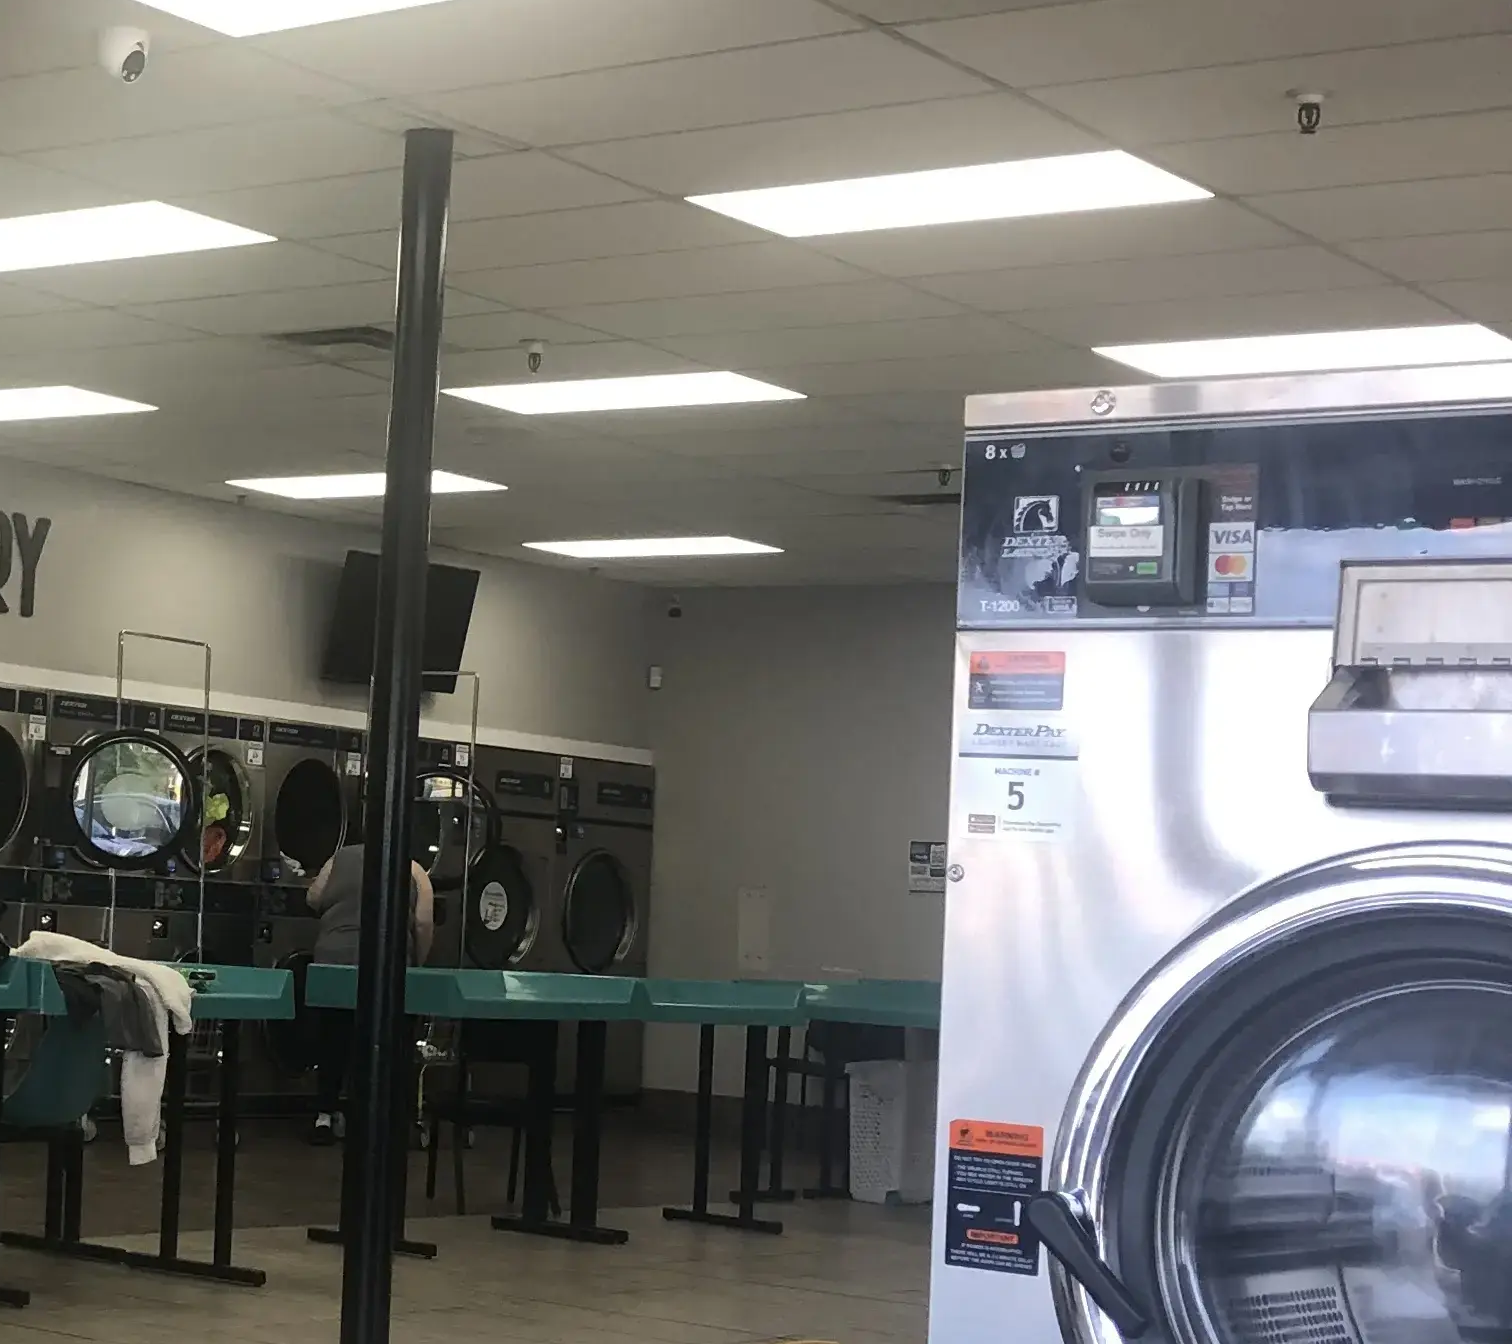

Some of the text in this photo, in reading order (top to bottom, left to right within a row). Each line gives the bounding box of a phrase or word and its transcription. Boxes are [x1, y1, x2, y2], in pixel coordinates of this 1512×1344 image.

[985, 444, 996, 459] 8
[1211, 529, 1253, 544] VISA
[980, 600, 1020, 613] T-1200
[1007, 781, 1025, 810] 5
